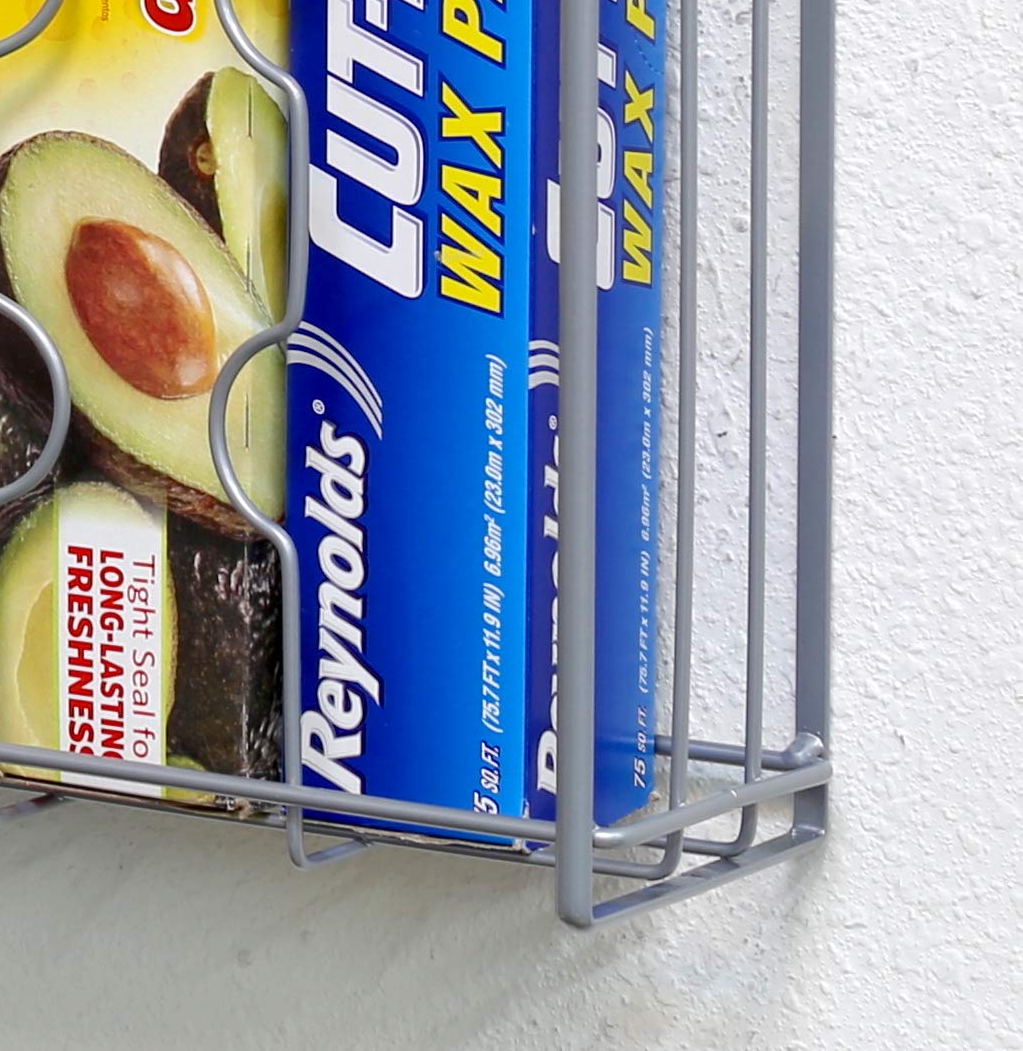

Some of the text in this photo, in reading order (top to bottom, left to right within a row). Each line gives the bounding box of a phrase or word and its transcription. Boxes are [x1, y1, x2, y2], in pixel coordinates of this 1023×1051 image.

[441, 80, 504, 314] WAX
[622, 69, 654, 285] WAX
[484, 354, 508, 399] mm)
[485, 398, 504, 435] 302
[127, 554, 155, 718] Tight Seal
[300, 421, 382, 796] Reynolds
[482, 614, 501, 650] 11.9
[633, 758, 647, 790] 75
